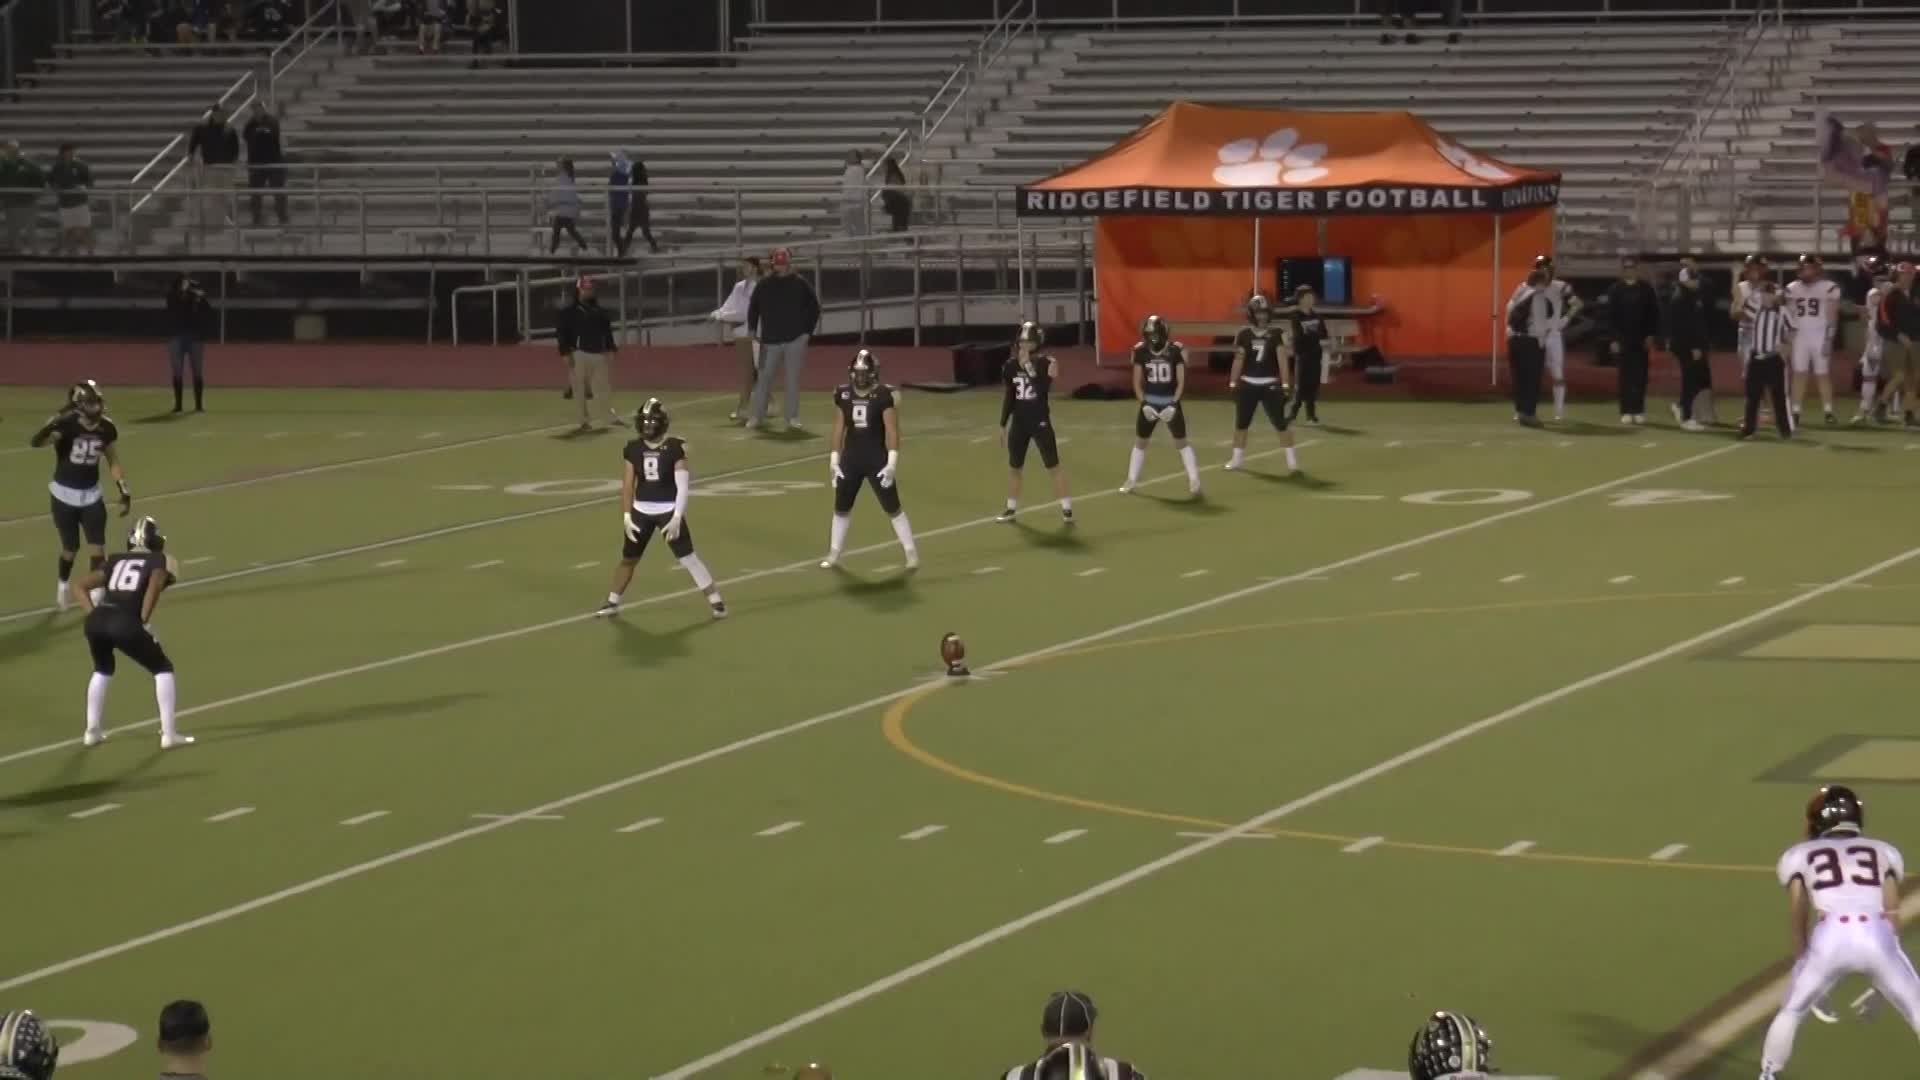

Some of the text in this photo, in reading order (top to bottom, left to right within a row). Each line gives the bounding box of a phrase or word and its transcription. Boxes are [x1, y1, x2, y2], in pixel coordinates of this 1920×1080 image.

[1026, 190, 1210, 211] RIDGEFIELD
[1221, 191, 1315, 210] TIGER
[1326, 190, 1487, 209] FOOTBALL
[1796, 298, 1819, 317] 59
[1252, 344, 1266, 361] 7
[1145, 363, 1171, 382] 30
[852, 405, 867, 428] 9
[70, 438, 102, 465] 85
[644, 457, 659, 480] 8
[108, 559, 145, 591] 16
[1808, 846, 1881, 890] 33
